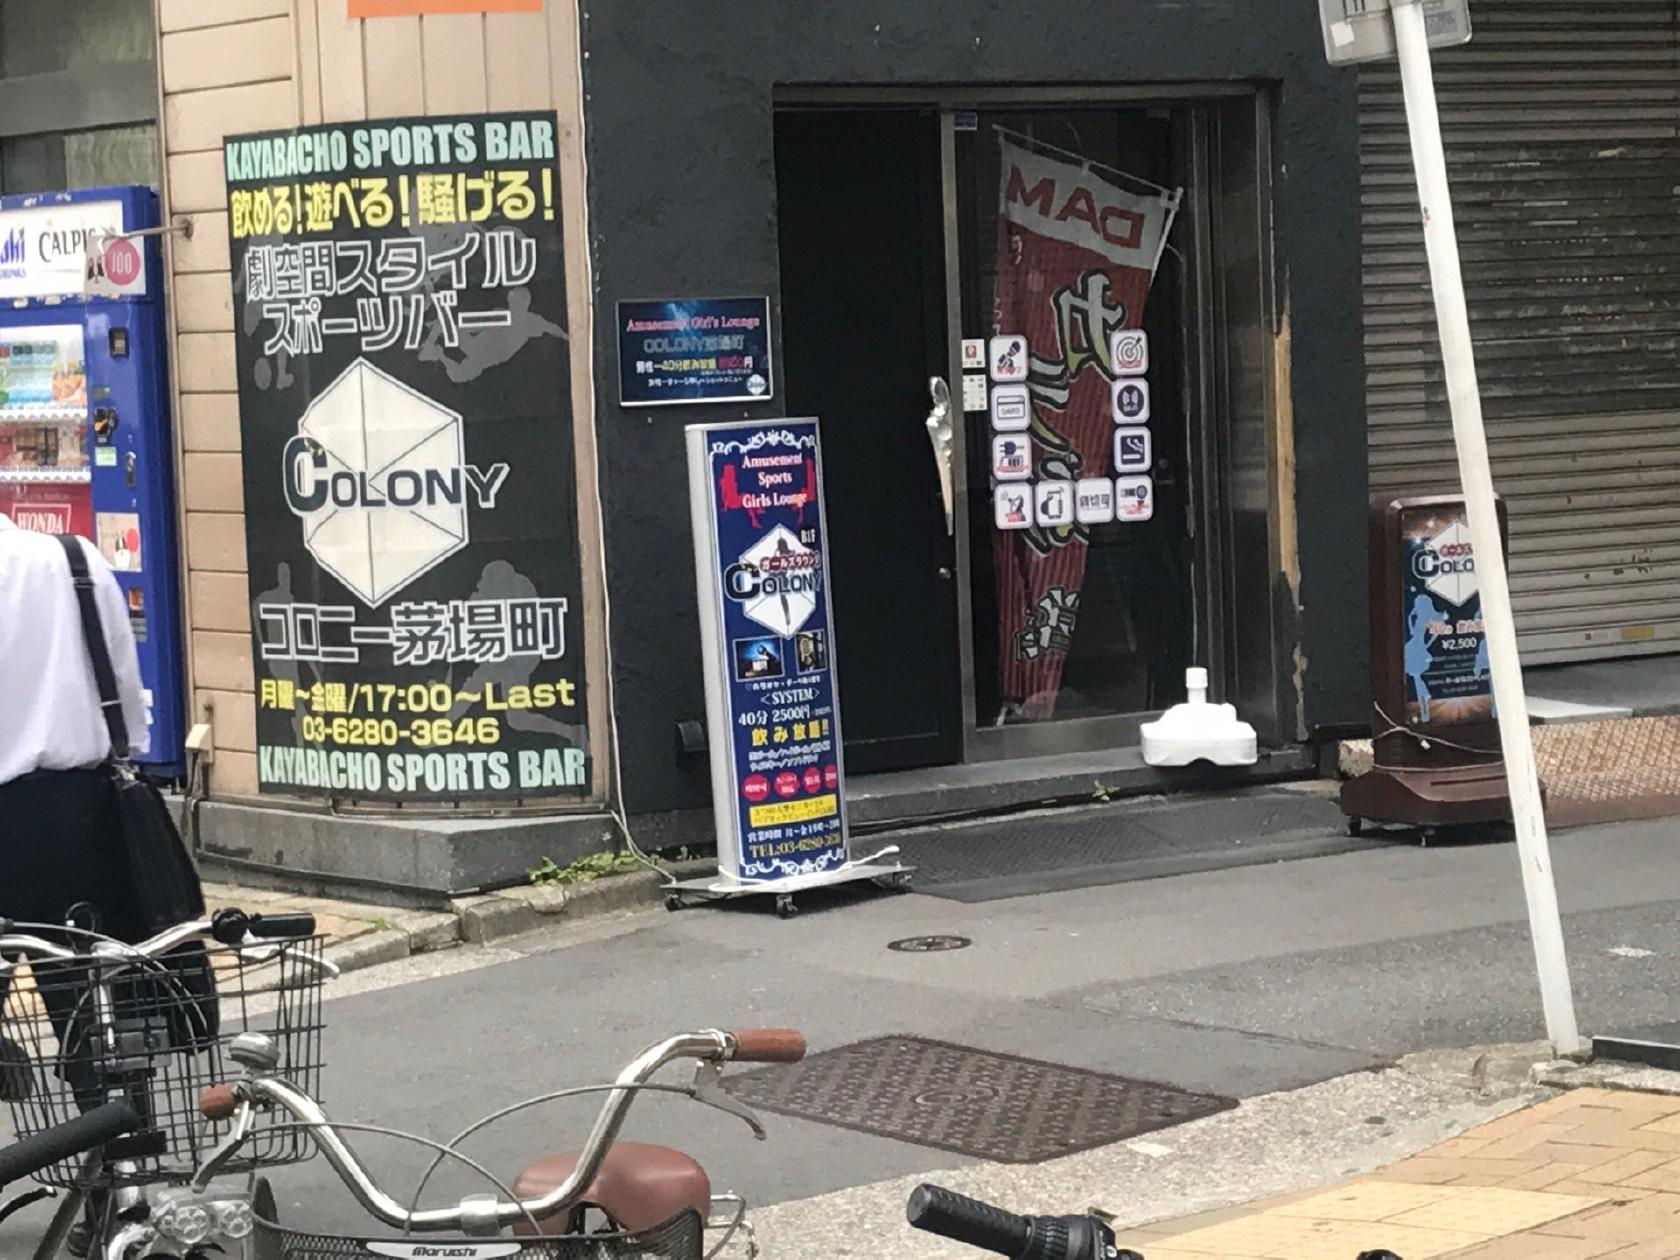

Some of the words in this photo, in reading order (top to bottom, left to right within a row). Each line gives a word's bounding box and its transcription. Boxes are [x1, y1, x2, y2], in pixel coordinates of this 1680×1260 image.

[226, 131, 346, 180] KAYABACHO
[353, 124, 477, 169] SPORTS
[485, 120, 555, 160] BAR
[246, 231, 537, 304] 劇空間スタイル
[262, 290, 512, 357] スポーツバー
[283, 435, 510, 518] COLONY
[742, 453, 803, 469] Amusement
[758, 471, 793, 489] Sports
[742, 494, 772, 509] Girls
[17, 512, 64, 535] WONDA
[724, 562, 822, 602] COLONY
[1412, 549, 1475, 581] COLO
[260, 598, 567, 666] コロニー茅場町
[303, 716, 501, 746] 03-6280-3646
[260, 746, 381, 791] KAYABACHO
[388, 751, 511, 792] SPORTS
[518, 747, 586, 789] BAR
